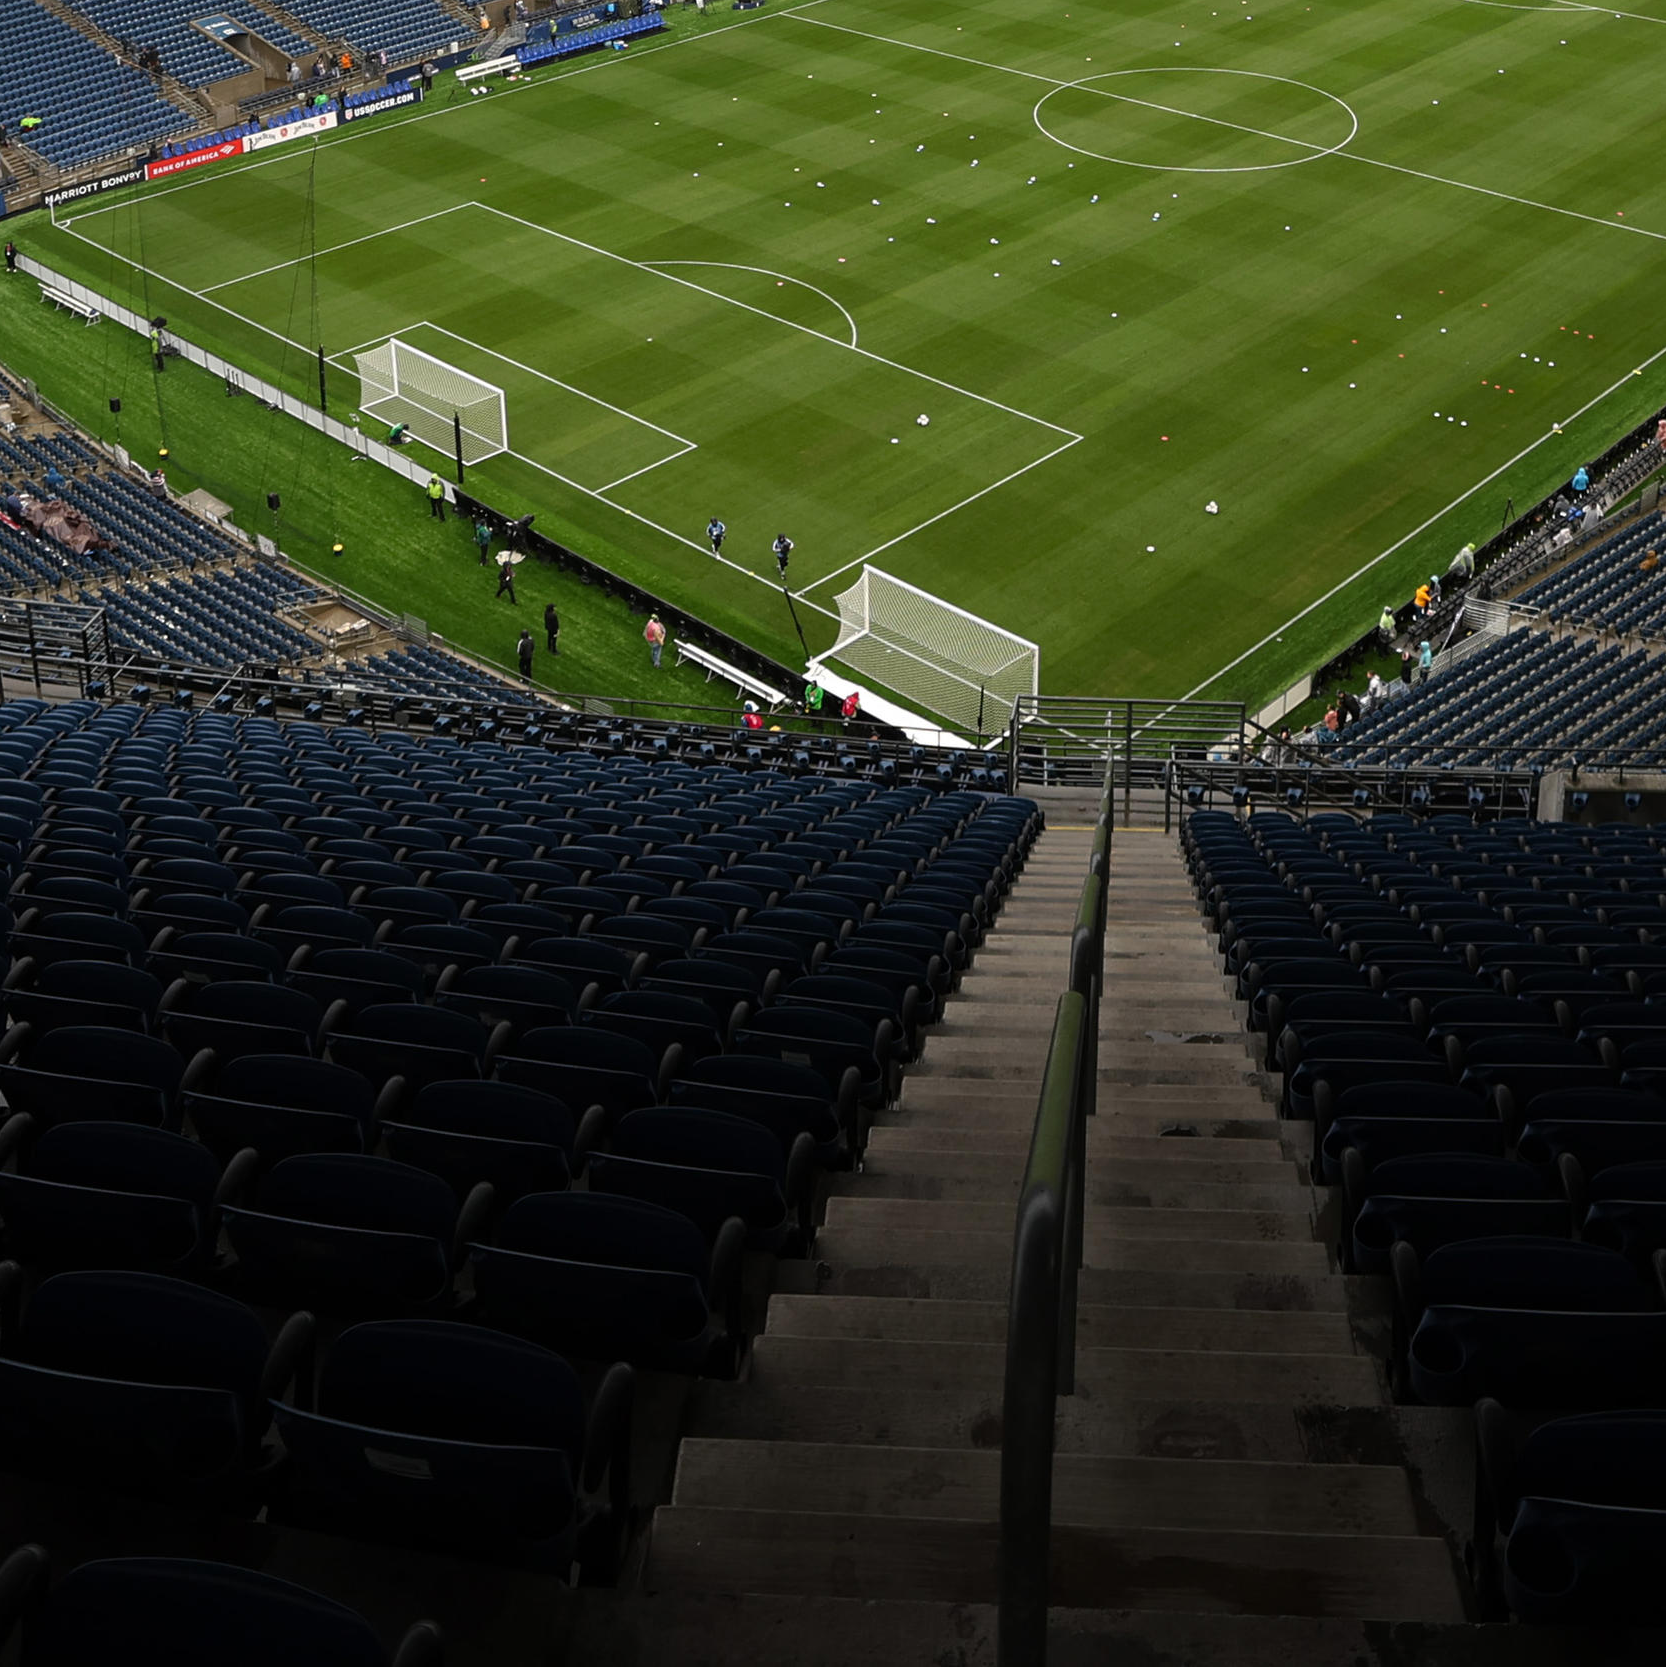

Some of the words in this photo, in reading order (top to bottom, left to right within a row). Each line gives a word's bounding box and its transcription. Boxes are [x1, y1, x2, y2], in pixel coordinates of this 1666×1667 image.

[353, 92, 414, 117] USSOCCER.COM
[153, 165, 174, 175] BANK
[175, 161, 185, 169] OF
[185, 152, 220, 166] AMERICA
[44, 182, 99, 204] MARRIOTT
[101, 170, 143, 189] BONVOY
